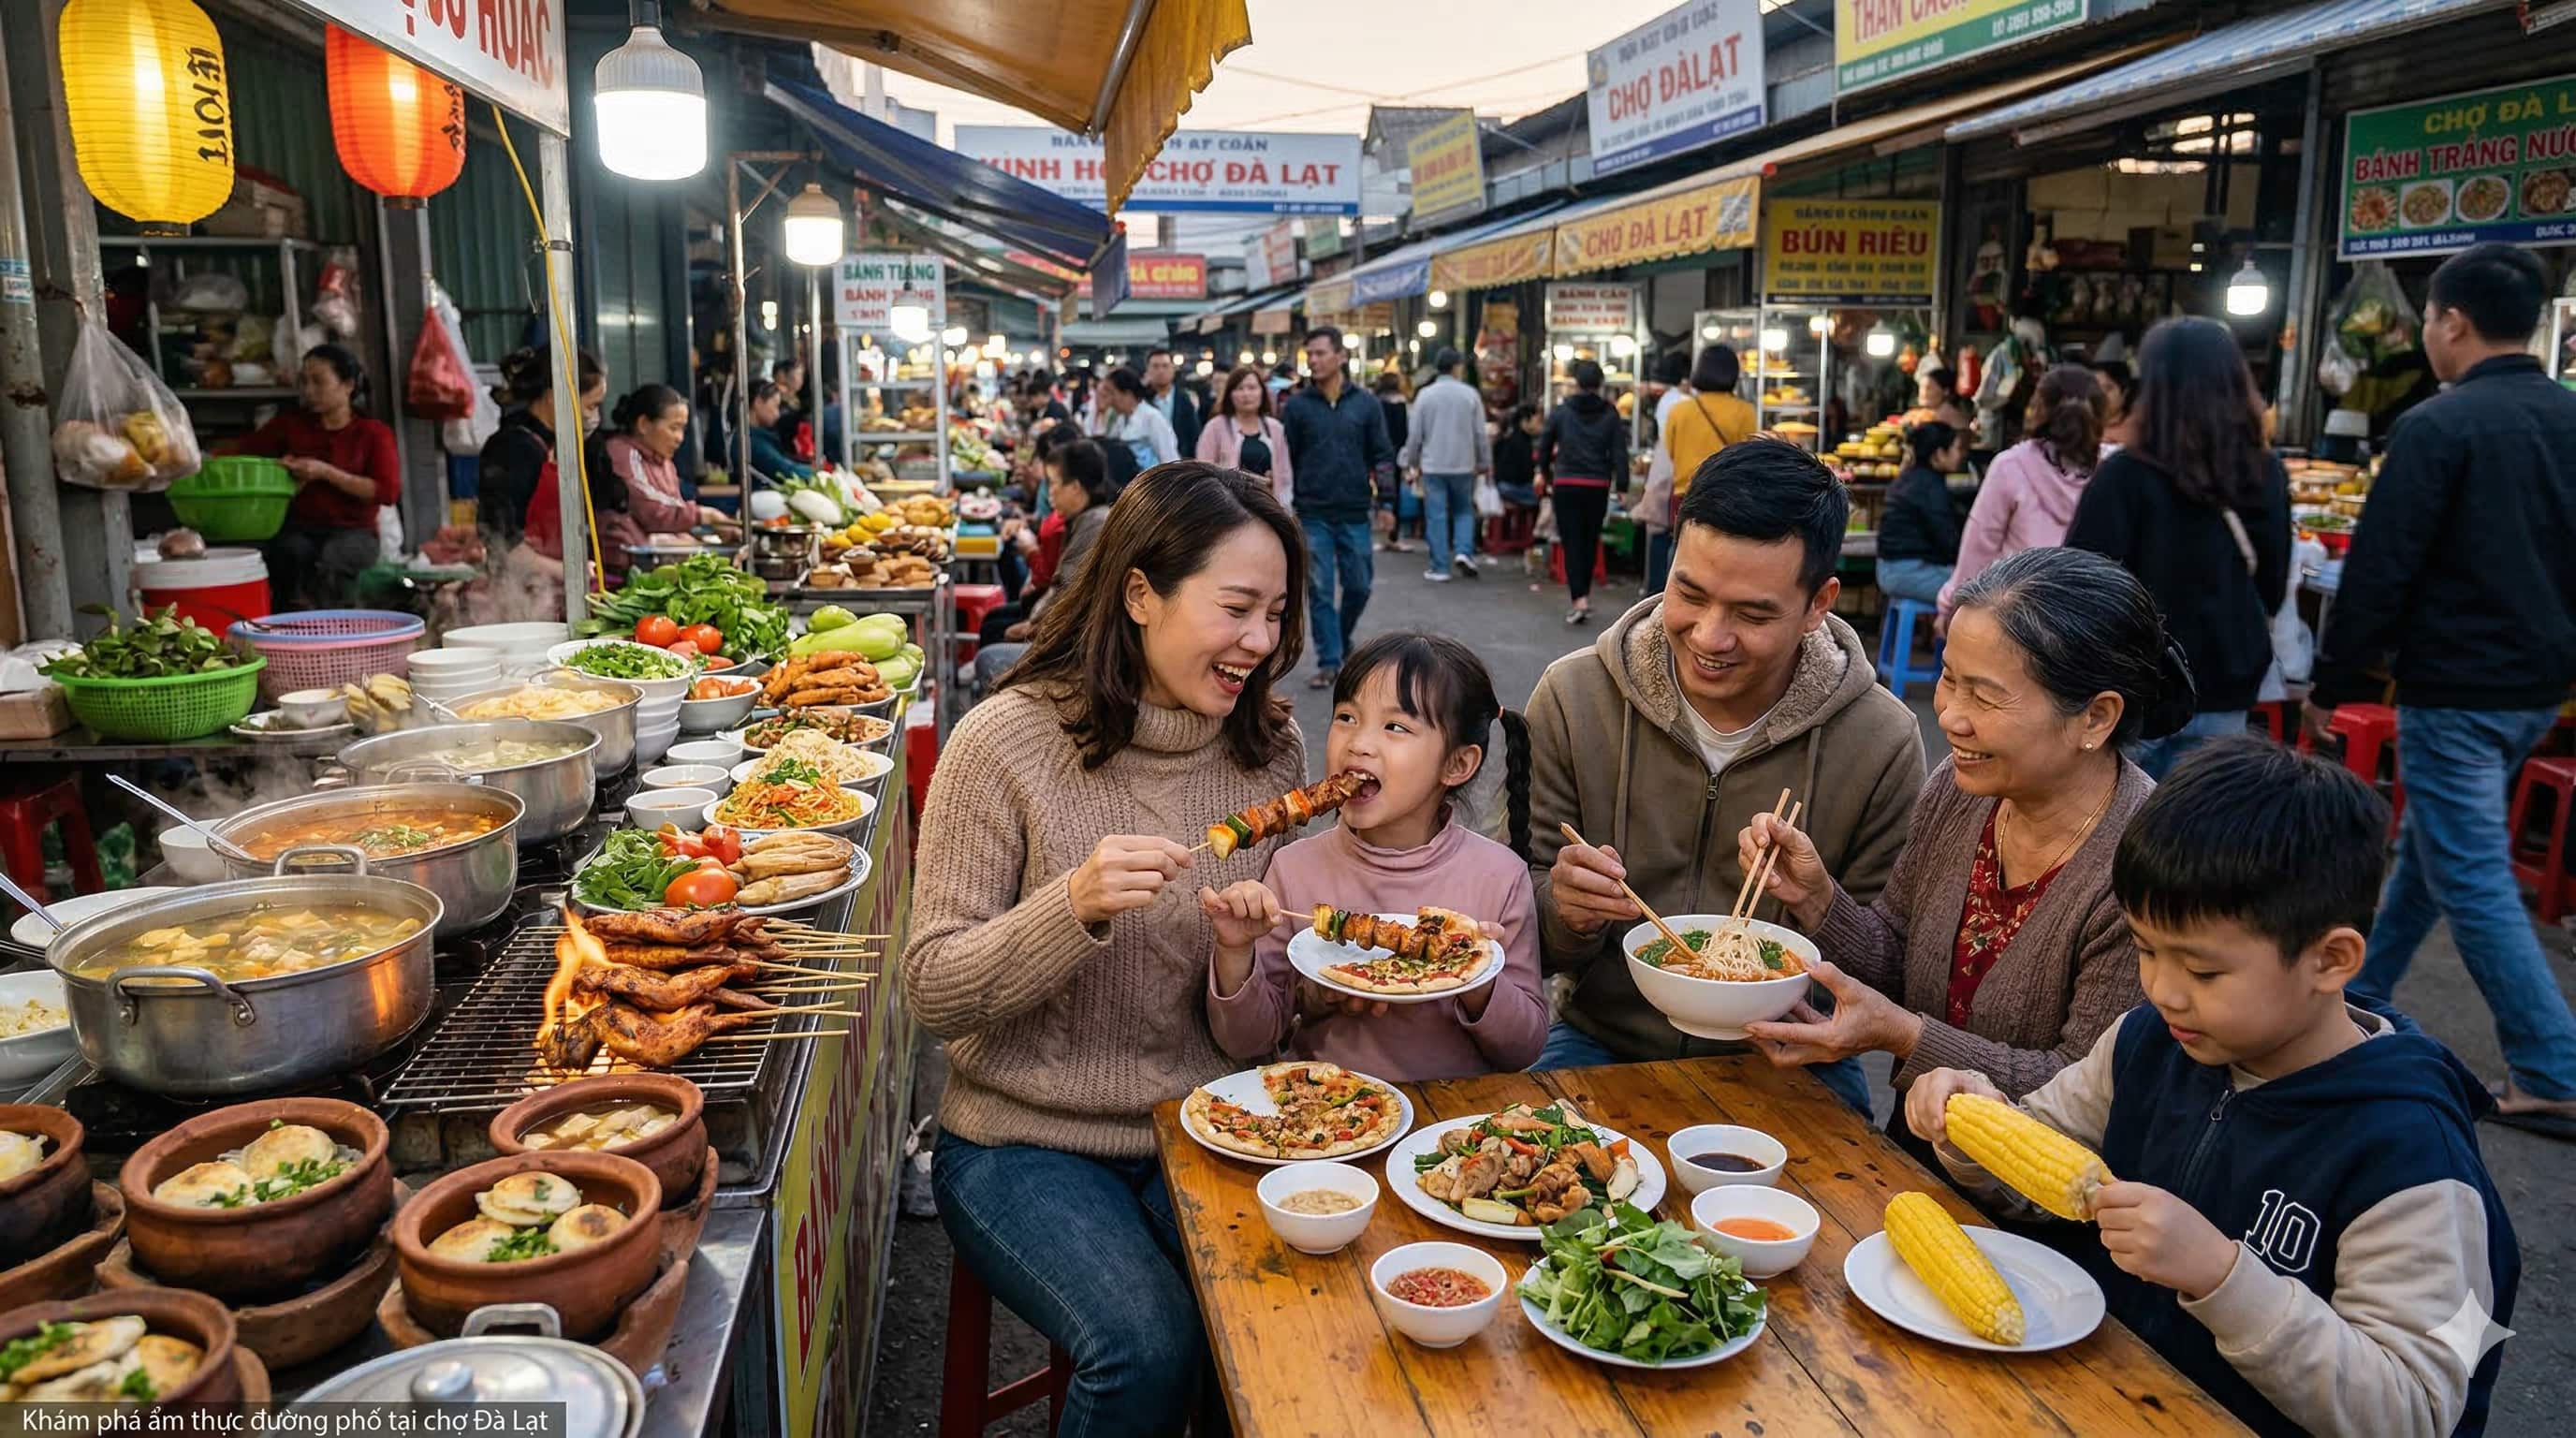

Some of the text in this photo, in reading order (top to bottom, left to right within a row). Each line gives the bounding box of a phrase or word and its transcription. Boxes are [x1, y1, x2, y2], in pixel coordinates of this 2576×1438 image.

[1608, 67, 1652, 122] CHỢ
[2424, 101, 2488, 134] CHỢ
[2498, 92, 2543, 124] ĐÀ
[1146, 157, 1215, 187] CHỢ
[1224, 156, 1269, 184] ĐÀ
[1281, 164, 1341, 189] LẠT
[2354, 147, 2420, 183] BÁNH
[1781, 223, 1846, 255] BÚN
[2244, 1189, 2320, 1272] 10
